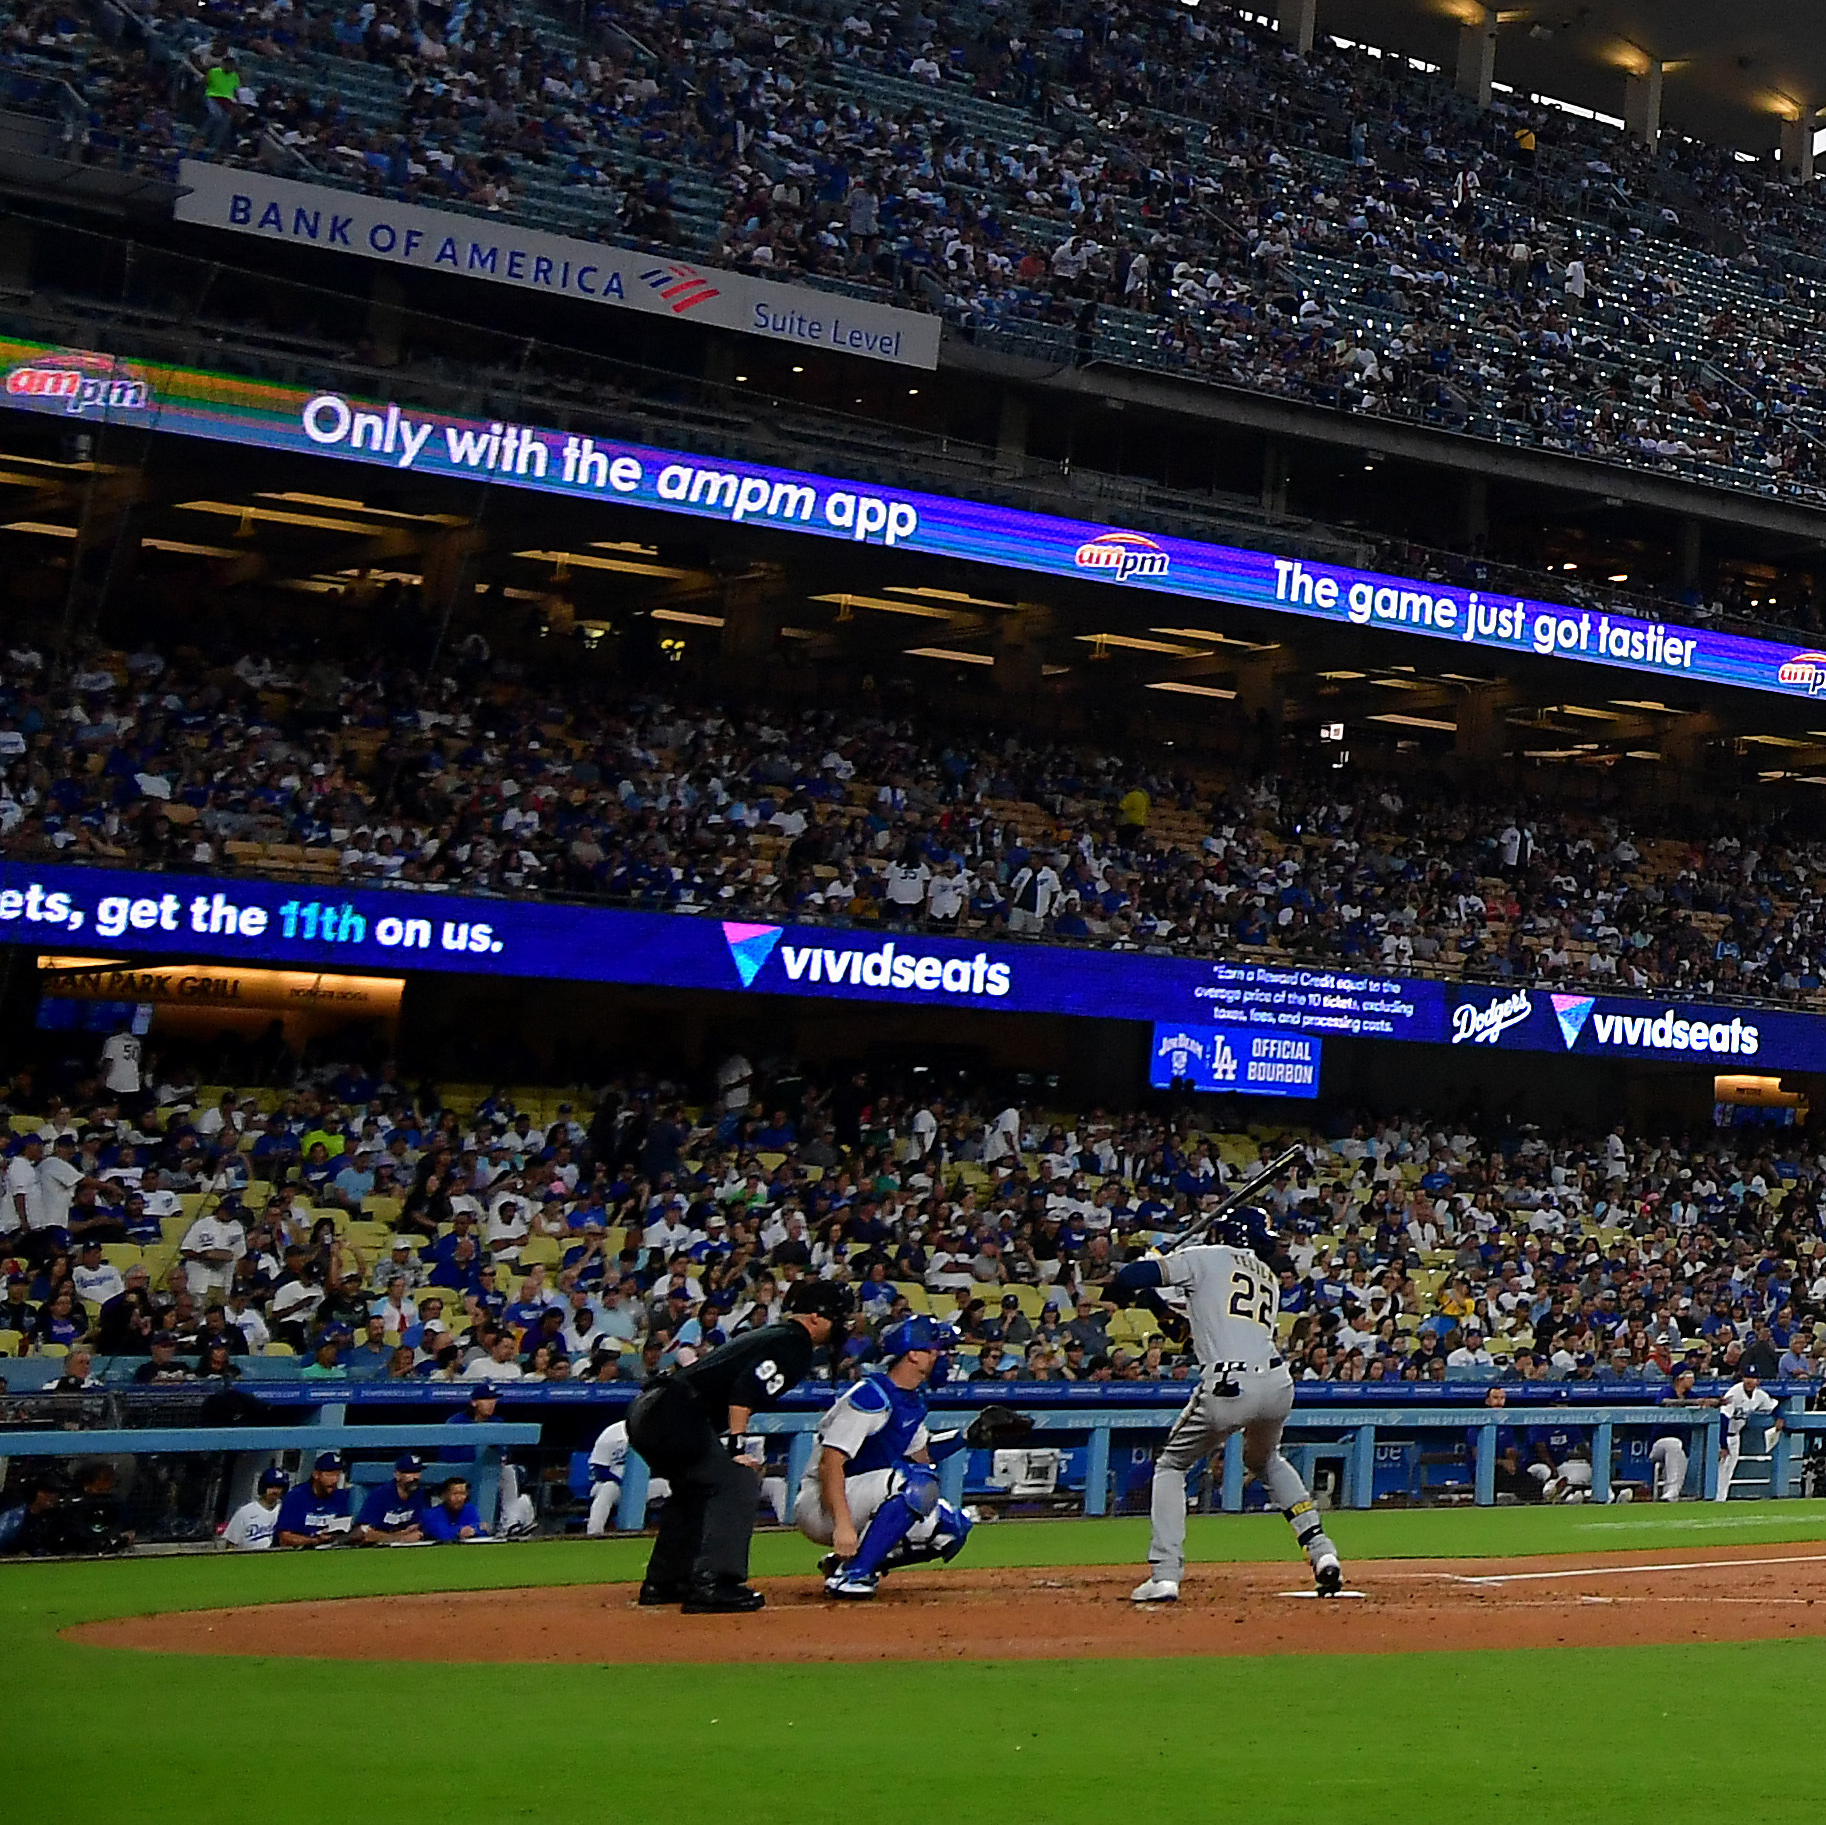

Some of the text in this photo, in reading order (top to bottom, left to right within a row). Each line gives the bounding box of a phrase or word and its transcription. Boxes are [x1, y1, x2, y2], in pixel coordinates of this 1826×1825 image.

[229, 193, 628, 301] BANK OF AMERICA
[752, 301, 902, 358] Suite Level
[301, 391, 918, 549] Only with the ampm app
[1074, 543, 1170, 582] ampm
[1273, 558, 1697, 670] The game just got tastier
[97, 894, 178, 937] get
[188, 895, 269, 936] the
[279, 902, 367, 944] 11th
[375, 916, 432, 948] on
[441, 921, 504, 953] us.
[110, 972, 172, 995] PARK
[178, 975, 242, 999] GRILL
[780, 943, 1012, 997] vividseats
[1257, 969, 1401, 994] Reward Credit equal the
[1194, 987, 1415, 1018] average price of the 10 tickets, excluding
[1277, 1012, 1301, 1025] and
[1302, 1014, 1361, 1033] processing
[1452, 988, 1533, 1044] Dodgers
[1252, 1037, 1312, 1061] OFFICIAL
[1592, 1008, 1760, 1056] vividseats
[1247, 1061, 1314, 1085] BOURBON
[1227, 1271, 1274, 1329] 22
